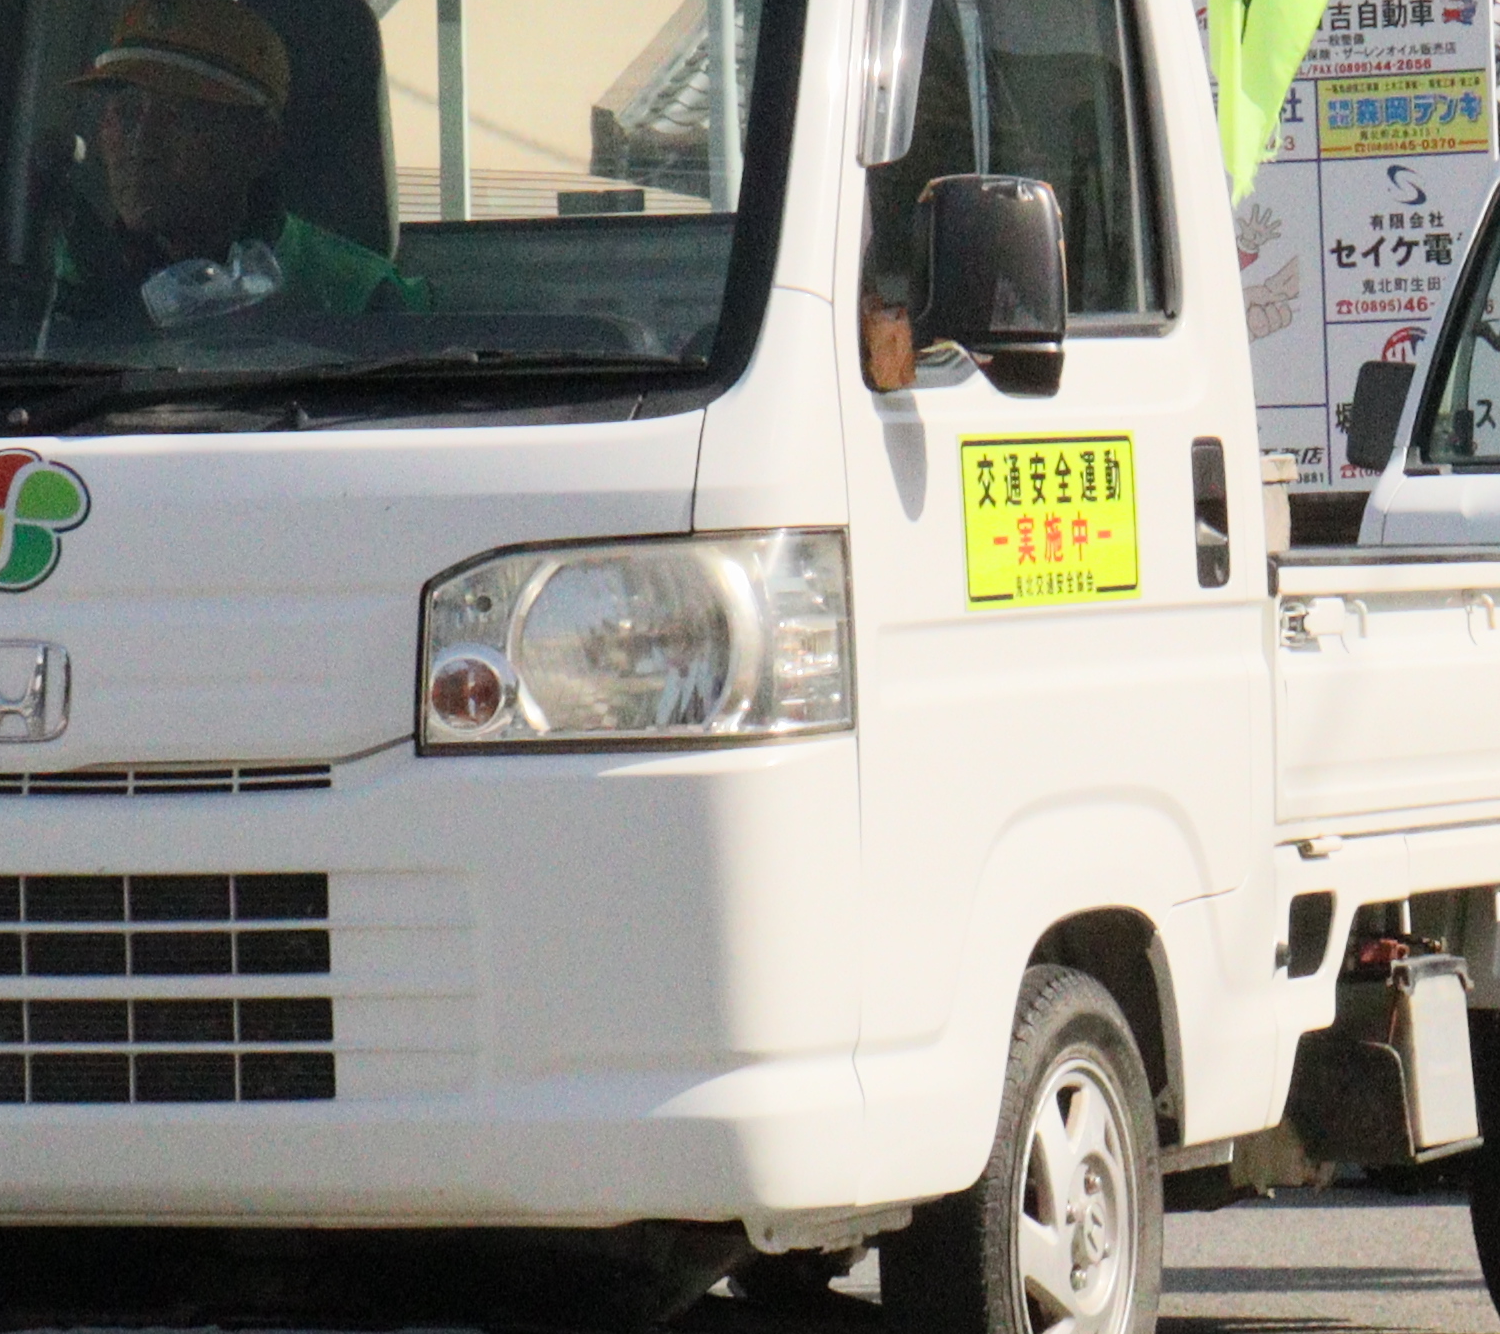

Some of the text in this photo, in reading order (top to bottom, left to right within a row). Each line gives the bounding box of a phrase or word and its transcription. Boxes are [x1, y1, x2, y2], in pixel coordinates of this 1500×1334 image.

[1369, 211, 1445, 231] 有限会社
[1330, 232, 1463, 269] セイケ電
[1361, 276, 1446, 295] 鬼北町生田
[976, 449, 1122, 510] 交通安全運動
